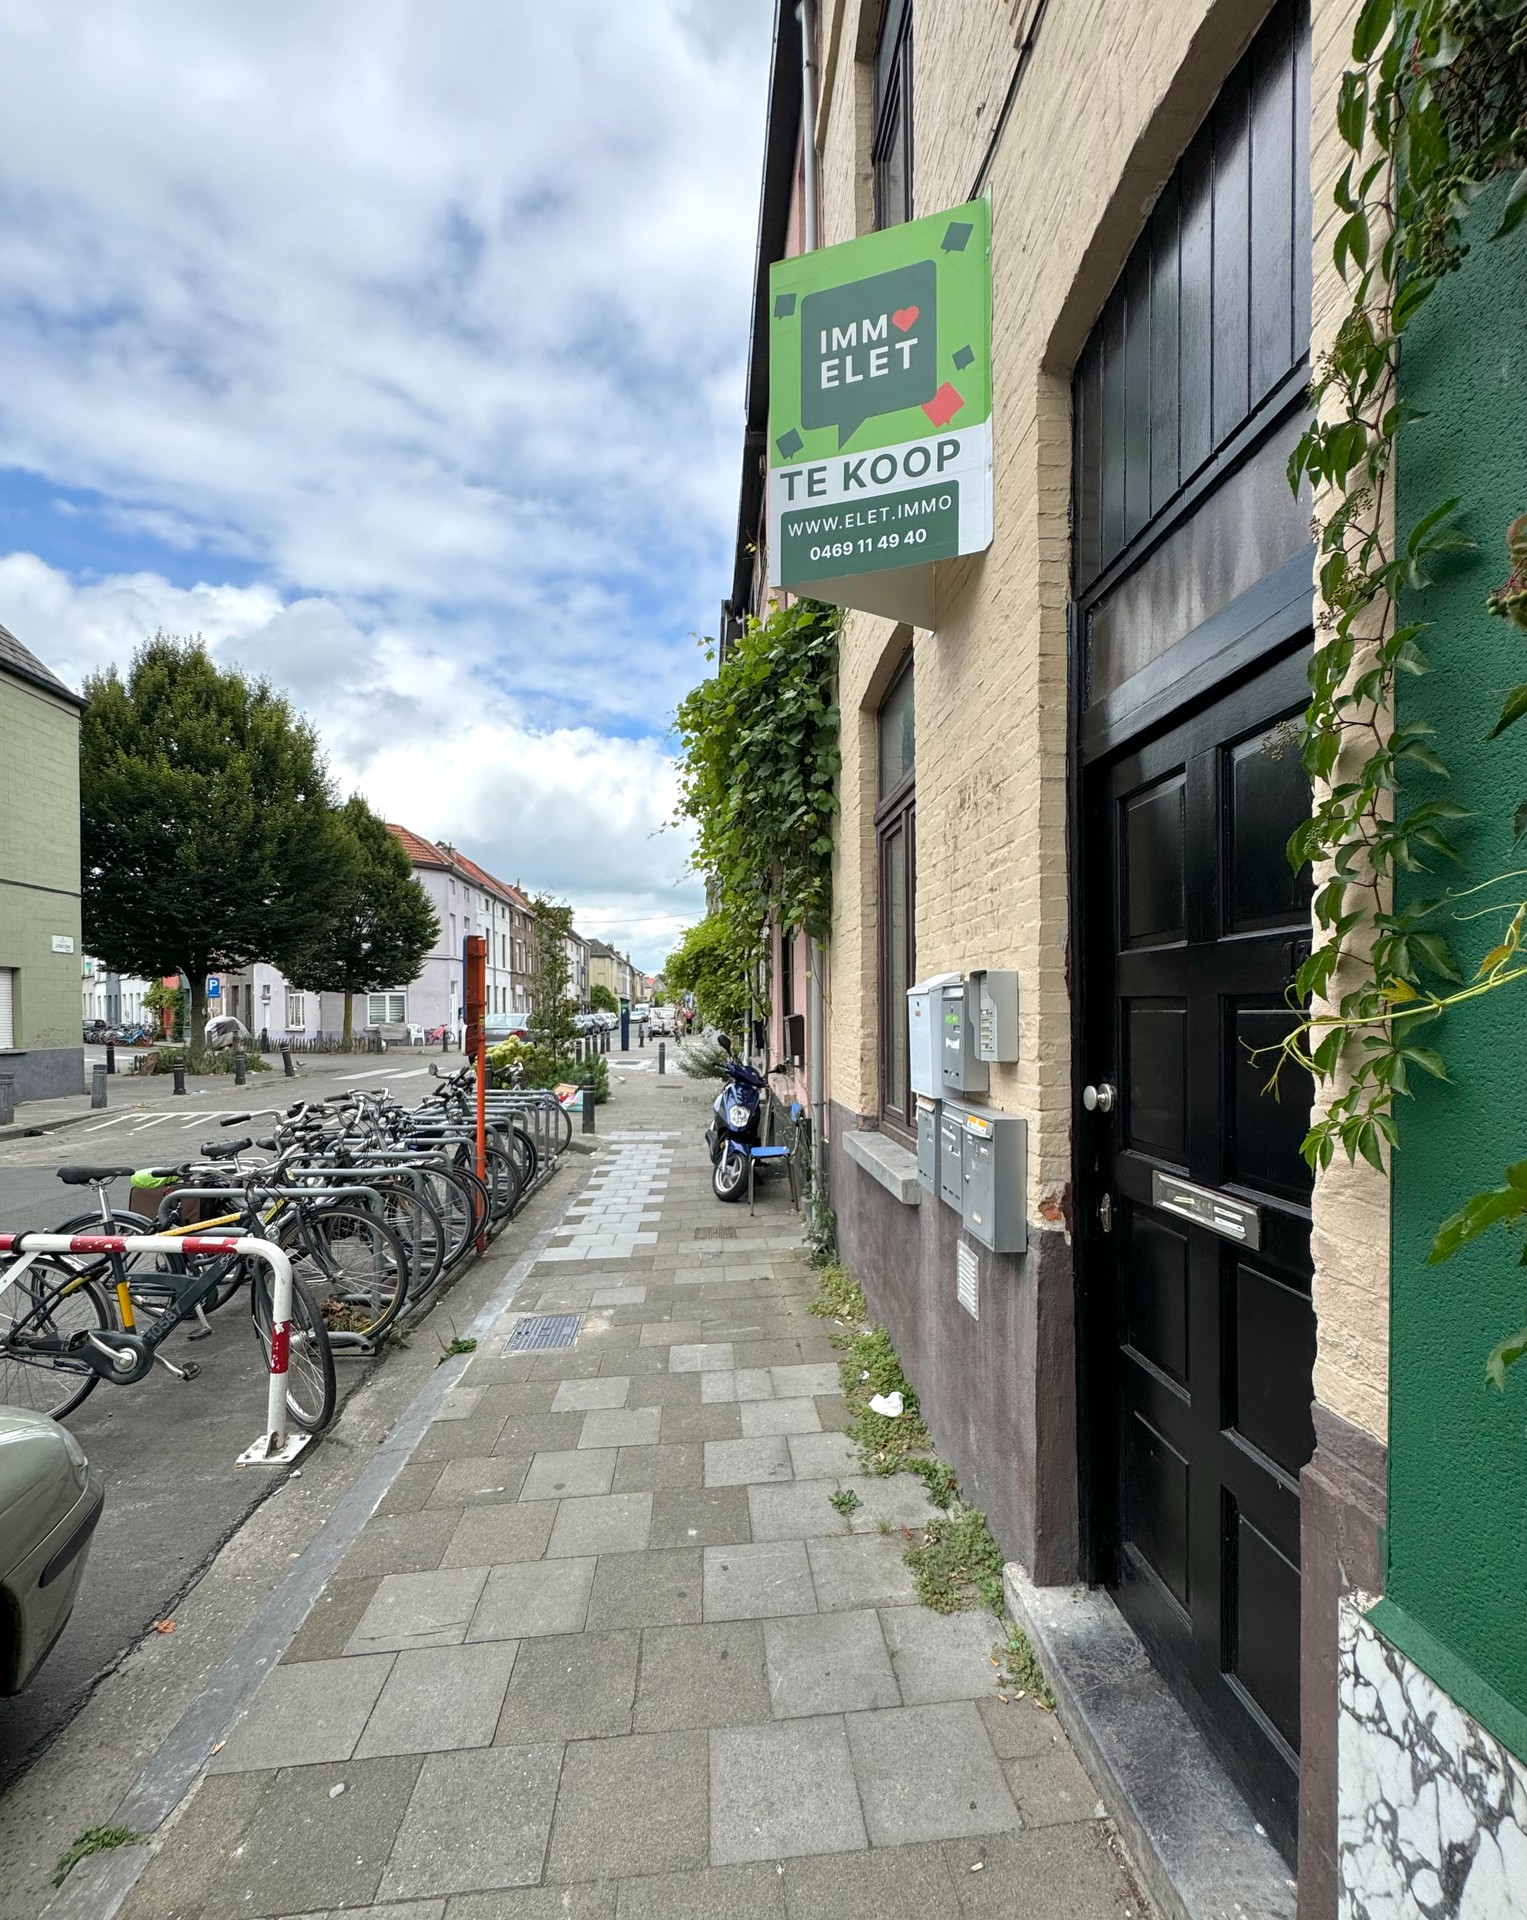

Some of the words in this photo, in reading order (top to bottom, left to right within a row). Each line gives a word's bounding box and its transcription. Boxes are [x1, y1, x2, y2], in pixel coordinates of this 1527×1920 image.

[820, 337, 919, 390] ELET
[779, 465, 827, 501] TE
[843, 438, 961, 492] KOOP
[788, 494, 952, 538] WWW.ELET.IMMO
[809, 541, 853, 561] 0469
[857, 537, 873, 553] 11
[877, 533, 900, 550] 49
[903, 528, 927, 545] 40
[209, 979, 218, 991] P
[146, 1302, 182, 1340] 10587
